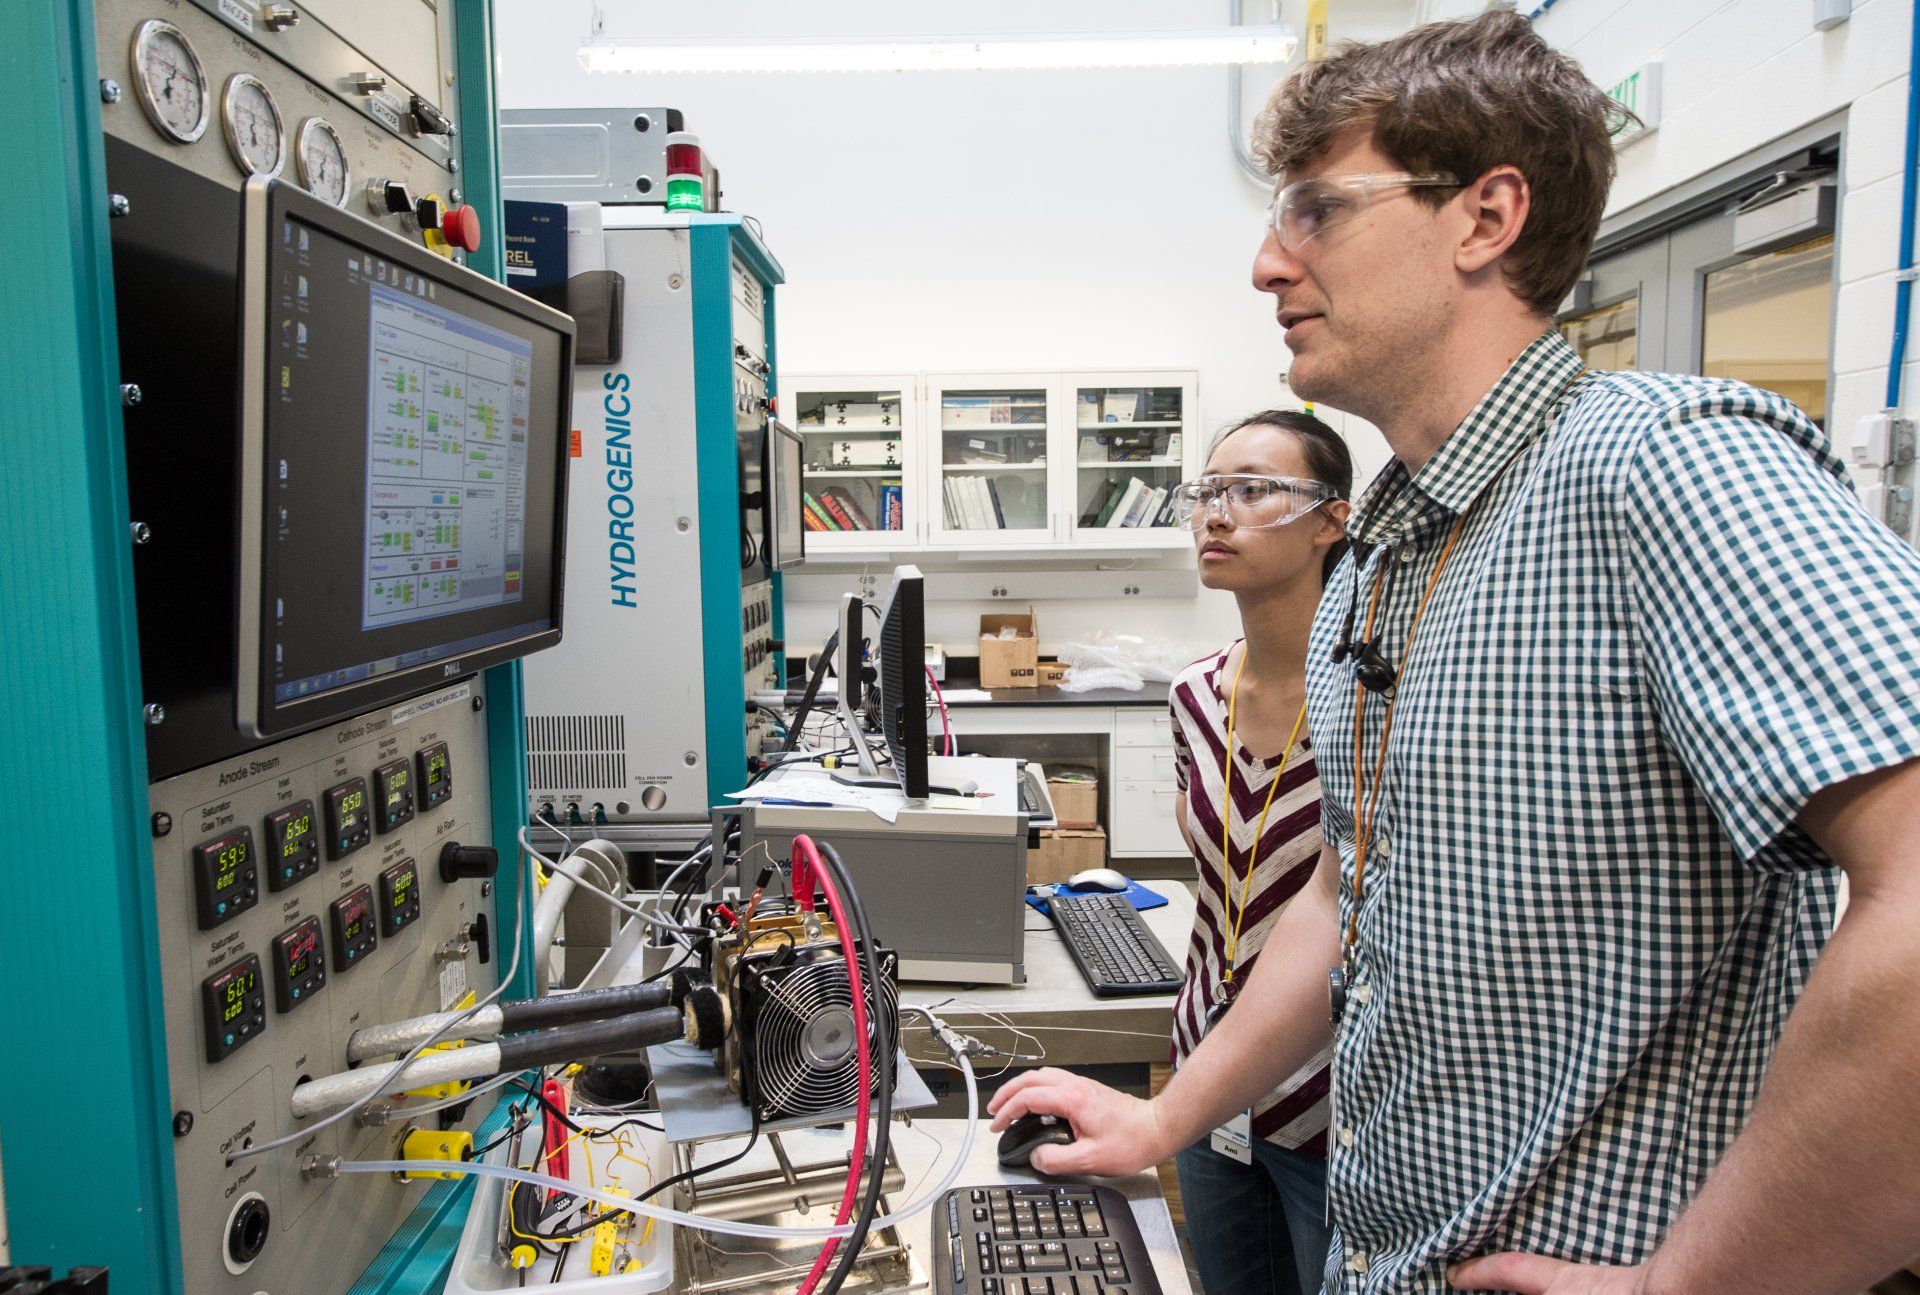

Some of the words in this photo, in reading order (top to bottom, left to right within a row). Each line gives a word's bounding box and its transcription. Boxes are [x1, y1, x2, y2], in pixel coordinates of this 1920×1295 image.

[1605, 71, 1640, 128] XIT
[603, 372, 637, 608] HYDROGENICS
[444, 662, 461, 677] DELL
[338, 726, 365, 744] Cathode
[366, 718, 387, 733] Stream
[219, 767, 248, 787] Anode
[250, 757, 280, 776] Stream
[201, 822, 215, 833] Gas
[216, 814, 234, 826] Temp
[202, 801, 231, 818] Saturator
[211, 930, 240, 952] Saturator
[220, 1136, 233, 1154] Cell
[234, 1120, 256, 1142] Voltage
[225, 1181, 238, 1199] Cell
[239, 1165, 258, 1185] Power
